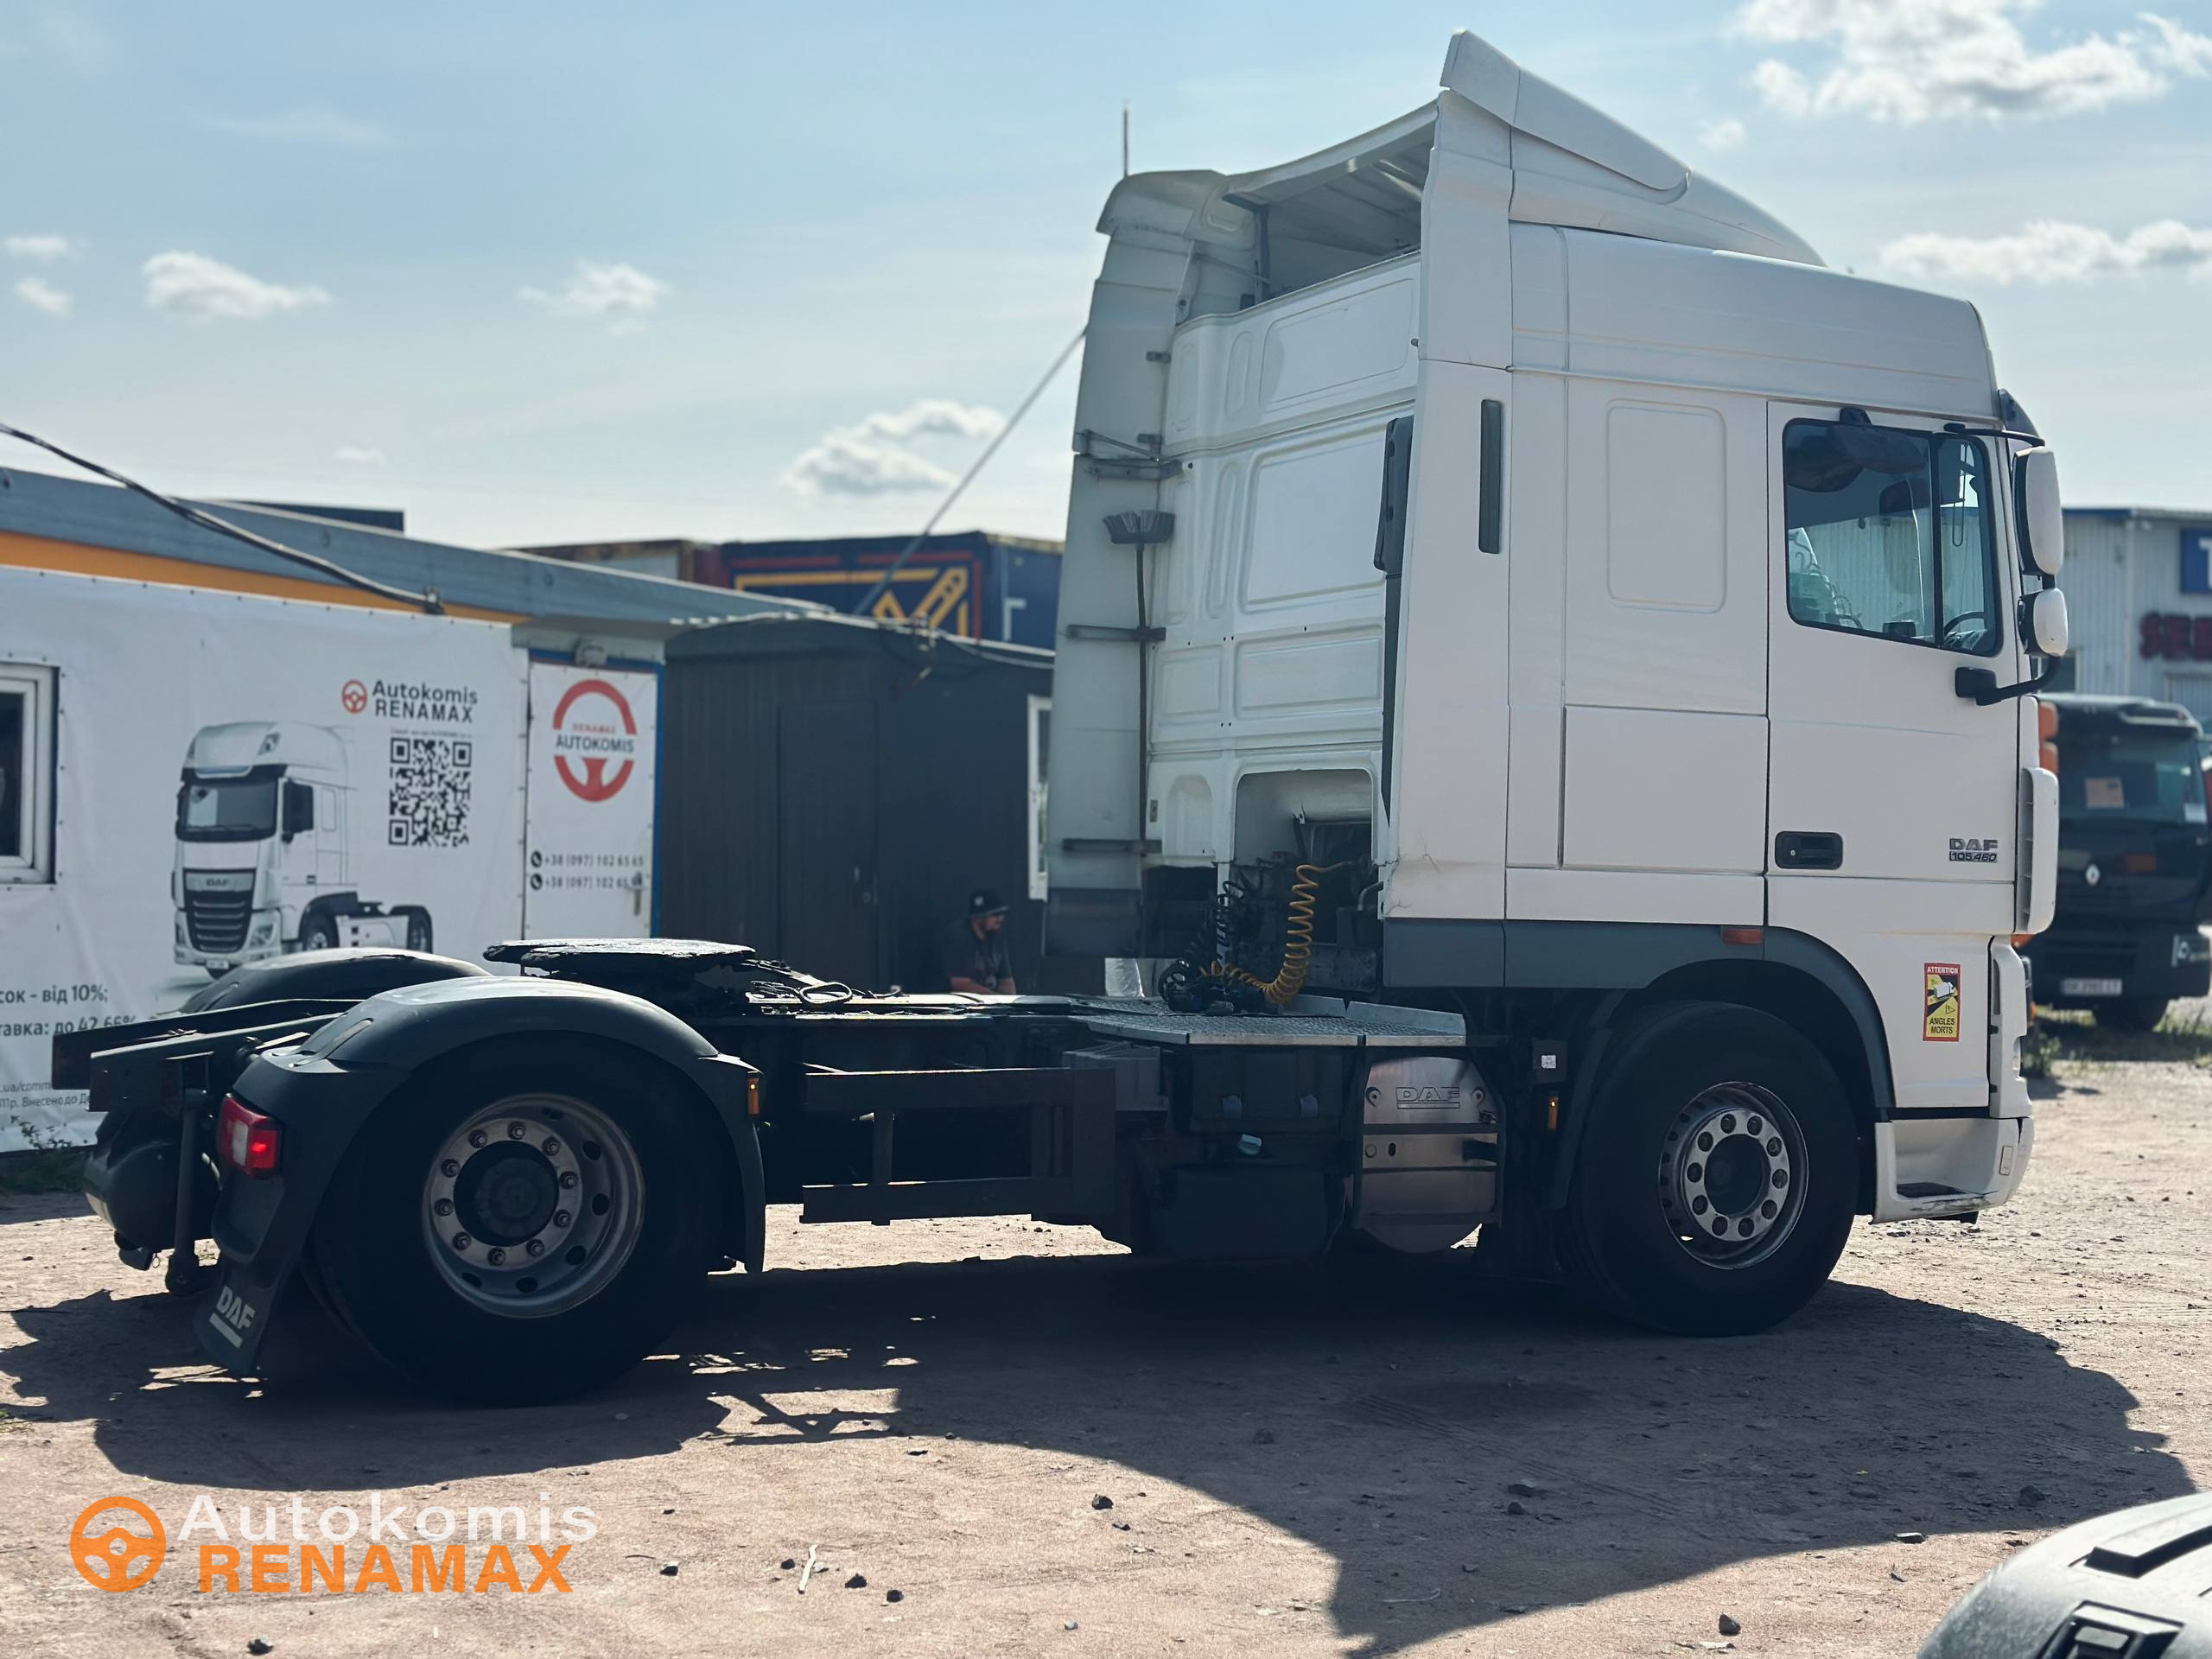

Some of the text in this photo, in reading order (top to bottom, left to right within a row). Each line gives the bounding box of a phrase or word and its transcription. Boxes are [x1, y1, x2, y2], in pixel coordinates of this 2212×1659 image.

[372, 679, 478, 705] Autokomis
[375, 698, 473, 723] RENAMAX
[556, 734, 634, 753] AUTOKOMIS
[1949, 838, 1998, 851] DAF
[1928, 966, 1959, 975] ATTENTION
[42, 984, 68, 1005] від
[72, 983, 109, 1003] 10%;
[1930, 1026, 1954, 1034] MORTS
[1395, 1086, 1460, 1102] DAF
[216, 1285, 256, 1329] DAF
